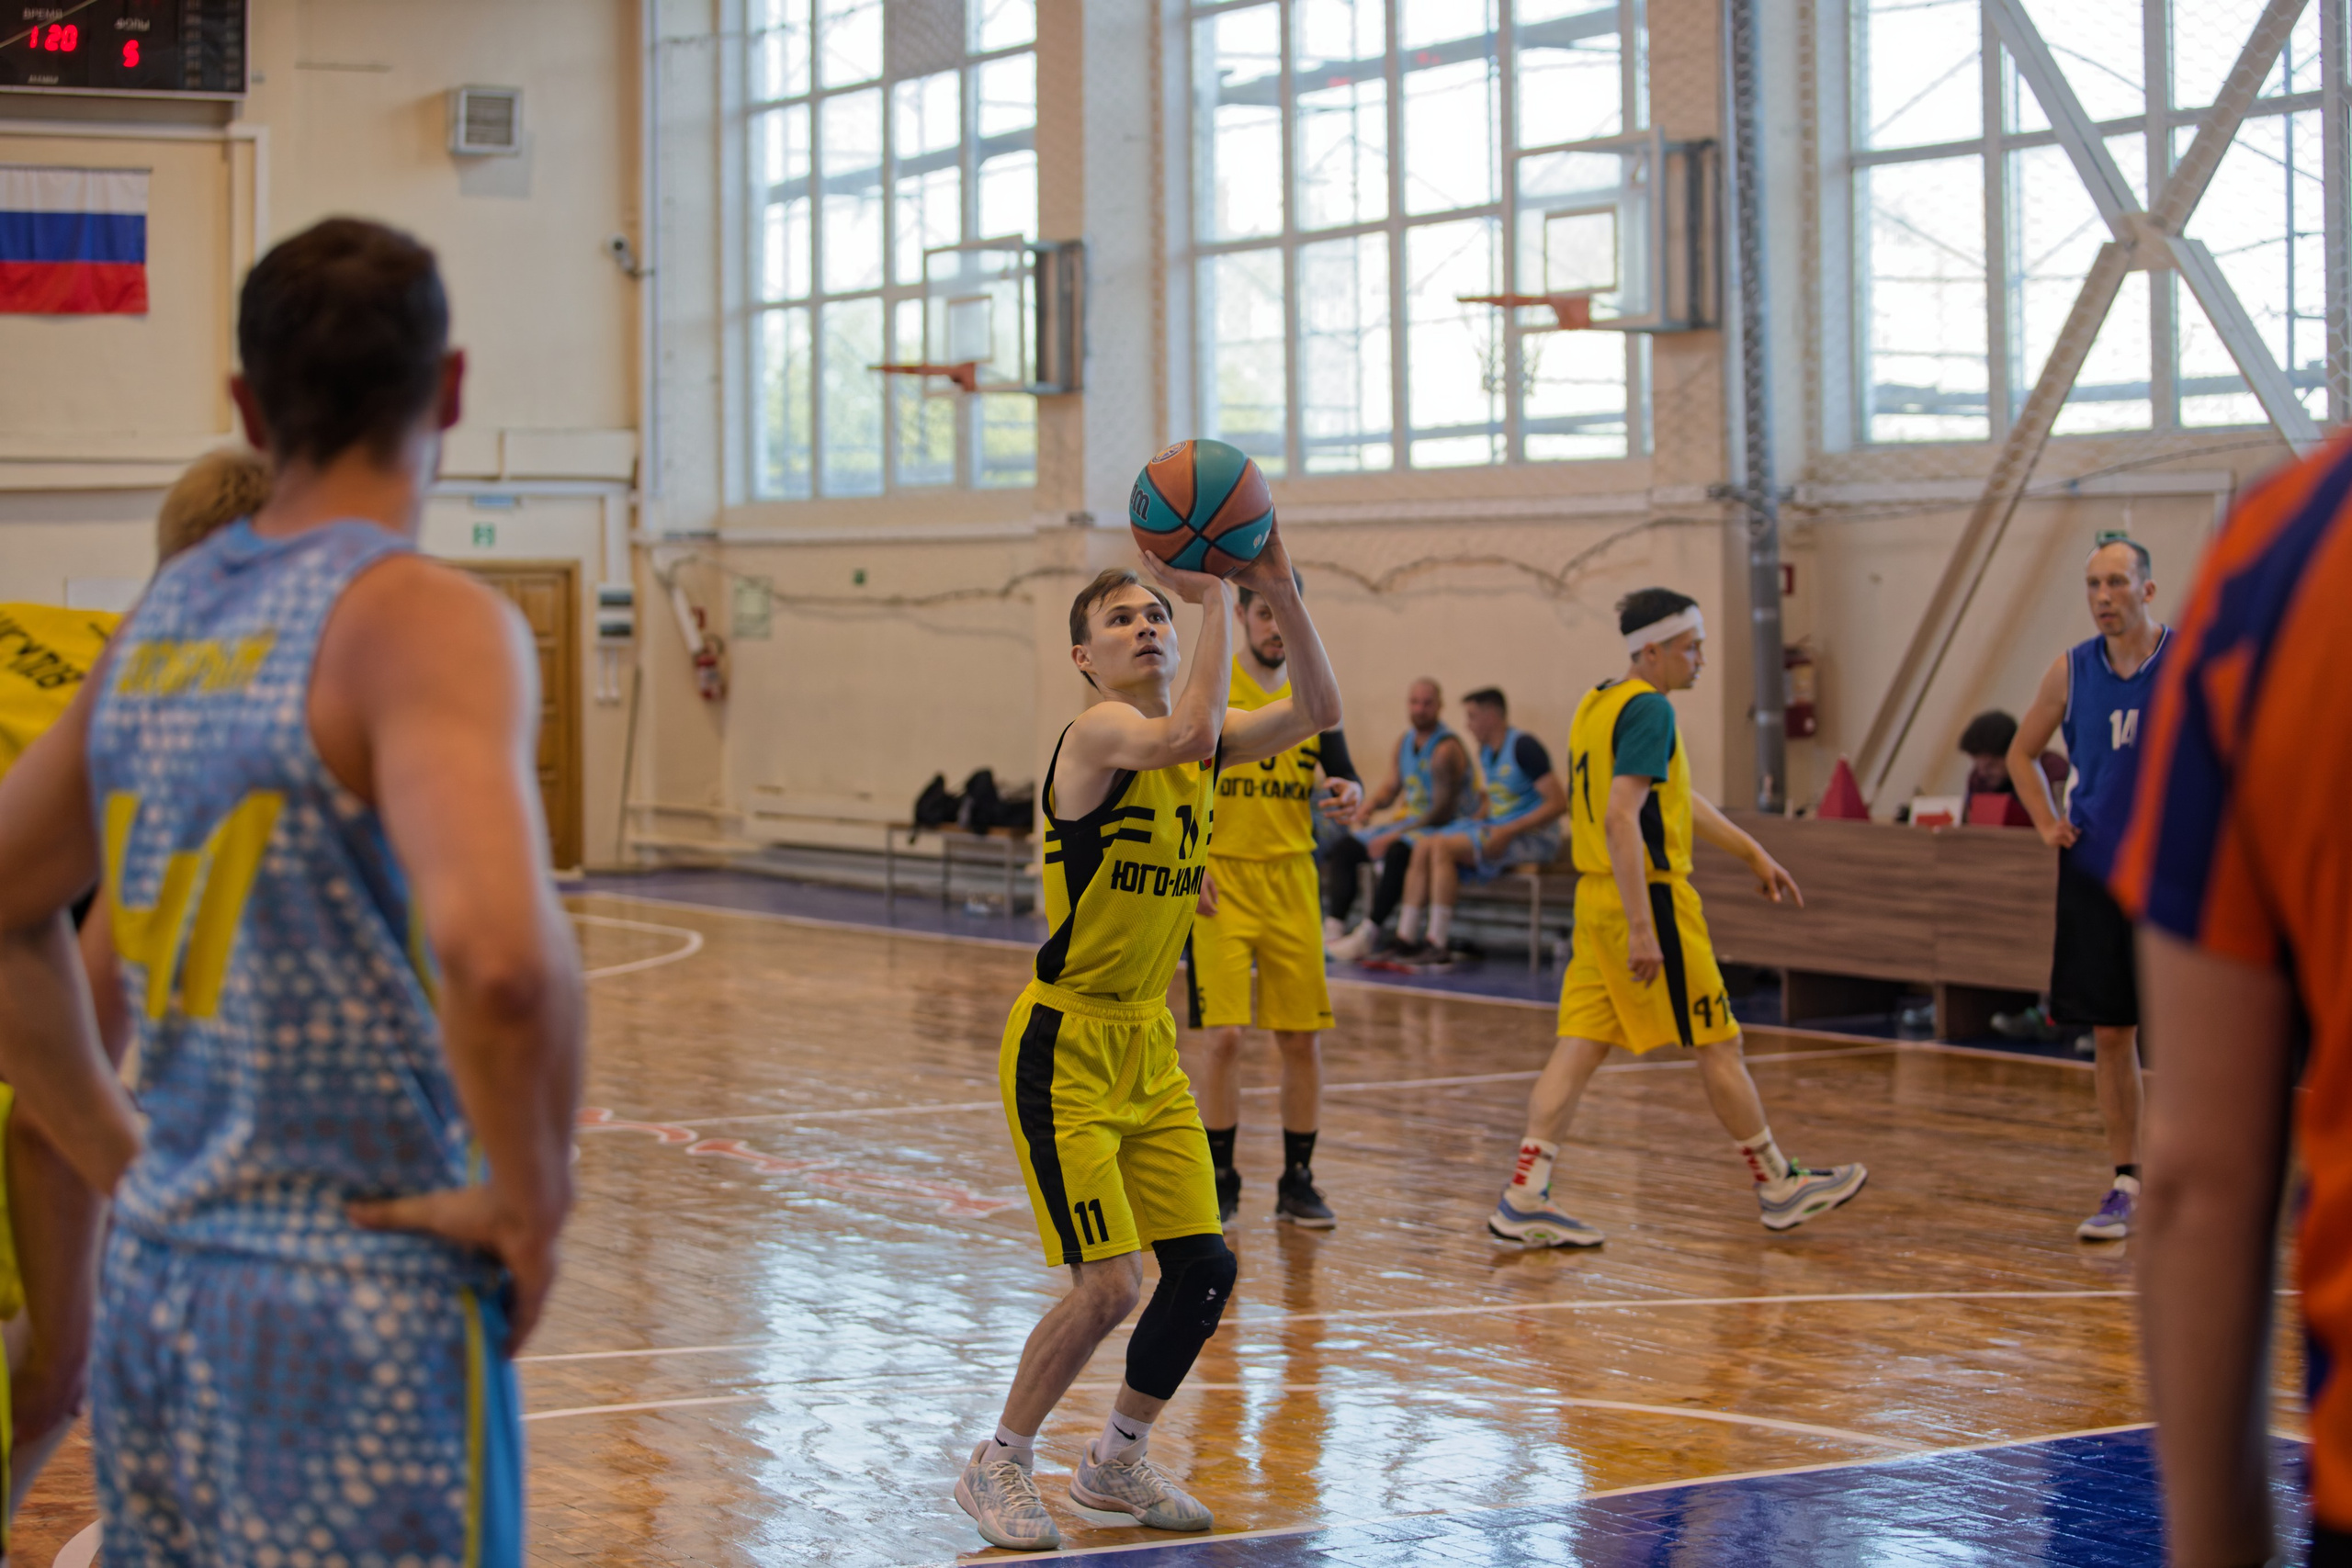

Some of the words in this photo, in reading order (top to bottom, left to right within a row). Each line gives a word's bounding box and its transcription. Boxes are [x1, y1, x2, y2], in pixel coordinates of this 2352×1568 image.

[23, 7, 63, 20] ВРЕМЯ
[114, 17, 151, 31] ФОЛЫ
[2109, 709, 2140, 751] 14
[1693, 993, 1729, 1028] 41
[1074, 1199, 1110, 1246] 11
